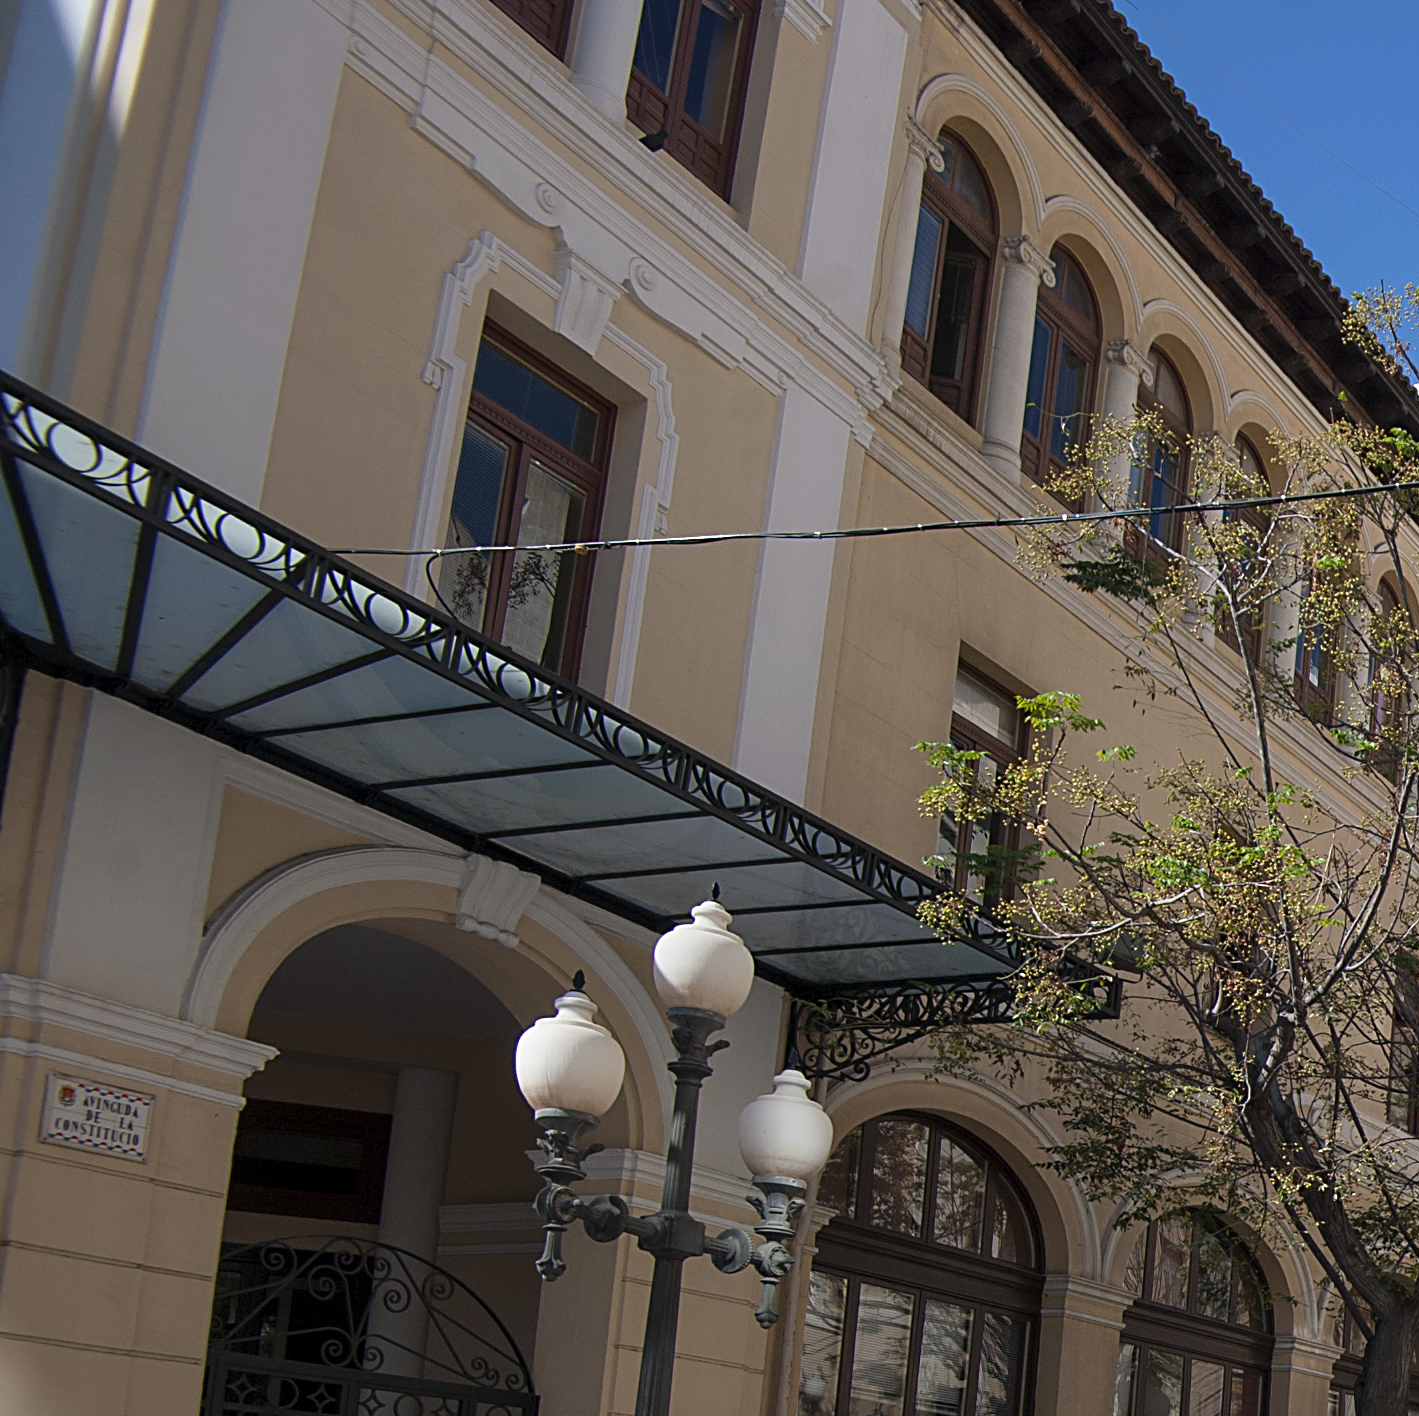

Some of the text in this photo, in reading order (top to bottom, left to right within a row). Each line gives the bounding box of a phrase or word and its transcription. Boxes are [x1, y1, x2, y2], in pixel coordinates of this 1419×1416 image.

[82, 1096, 139, 1119] AVINGUDA
[55, 1117, 139, 1146] CONSTITUCIO
[86, 1109, 133, 1131] DE LA
